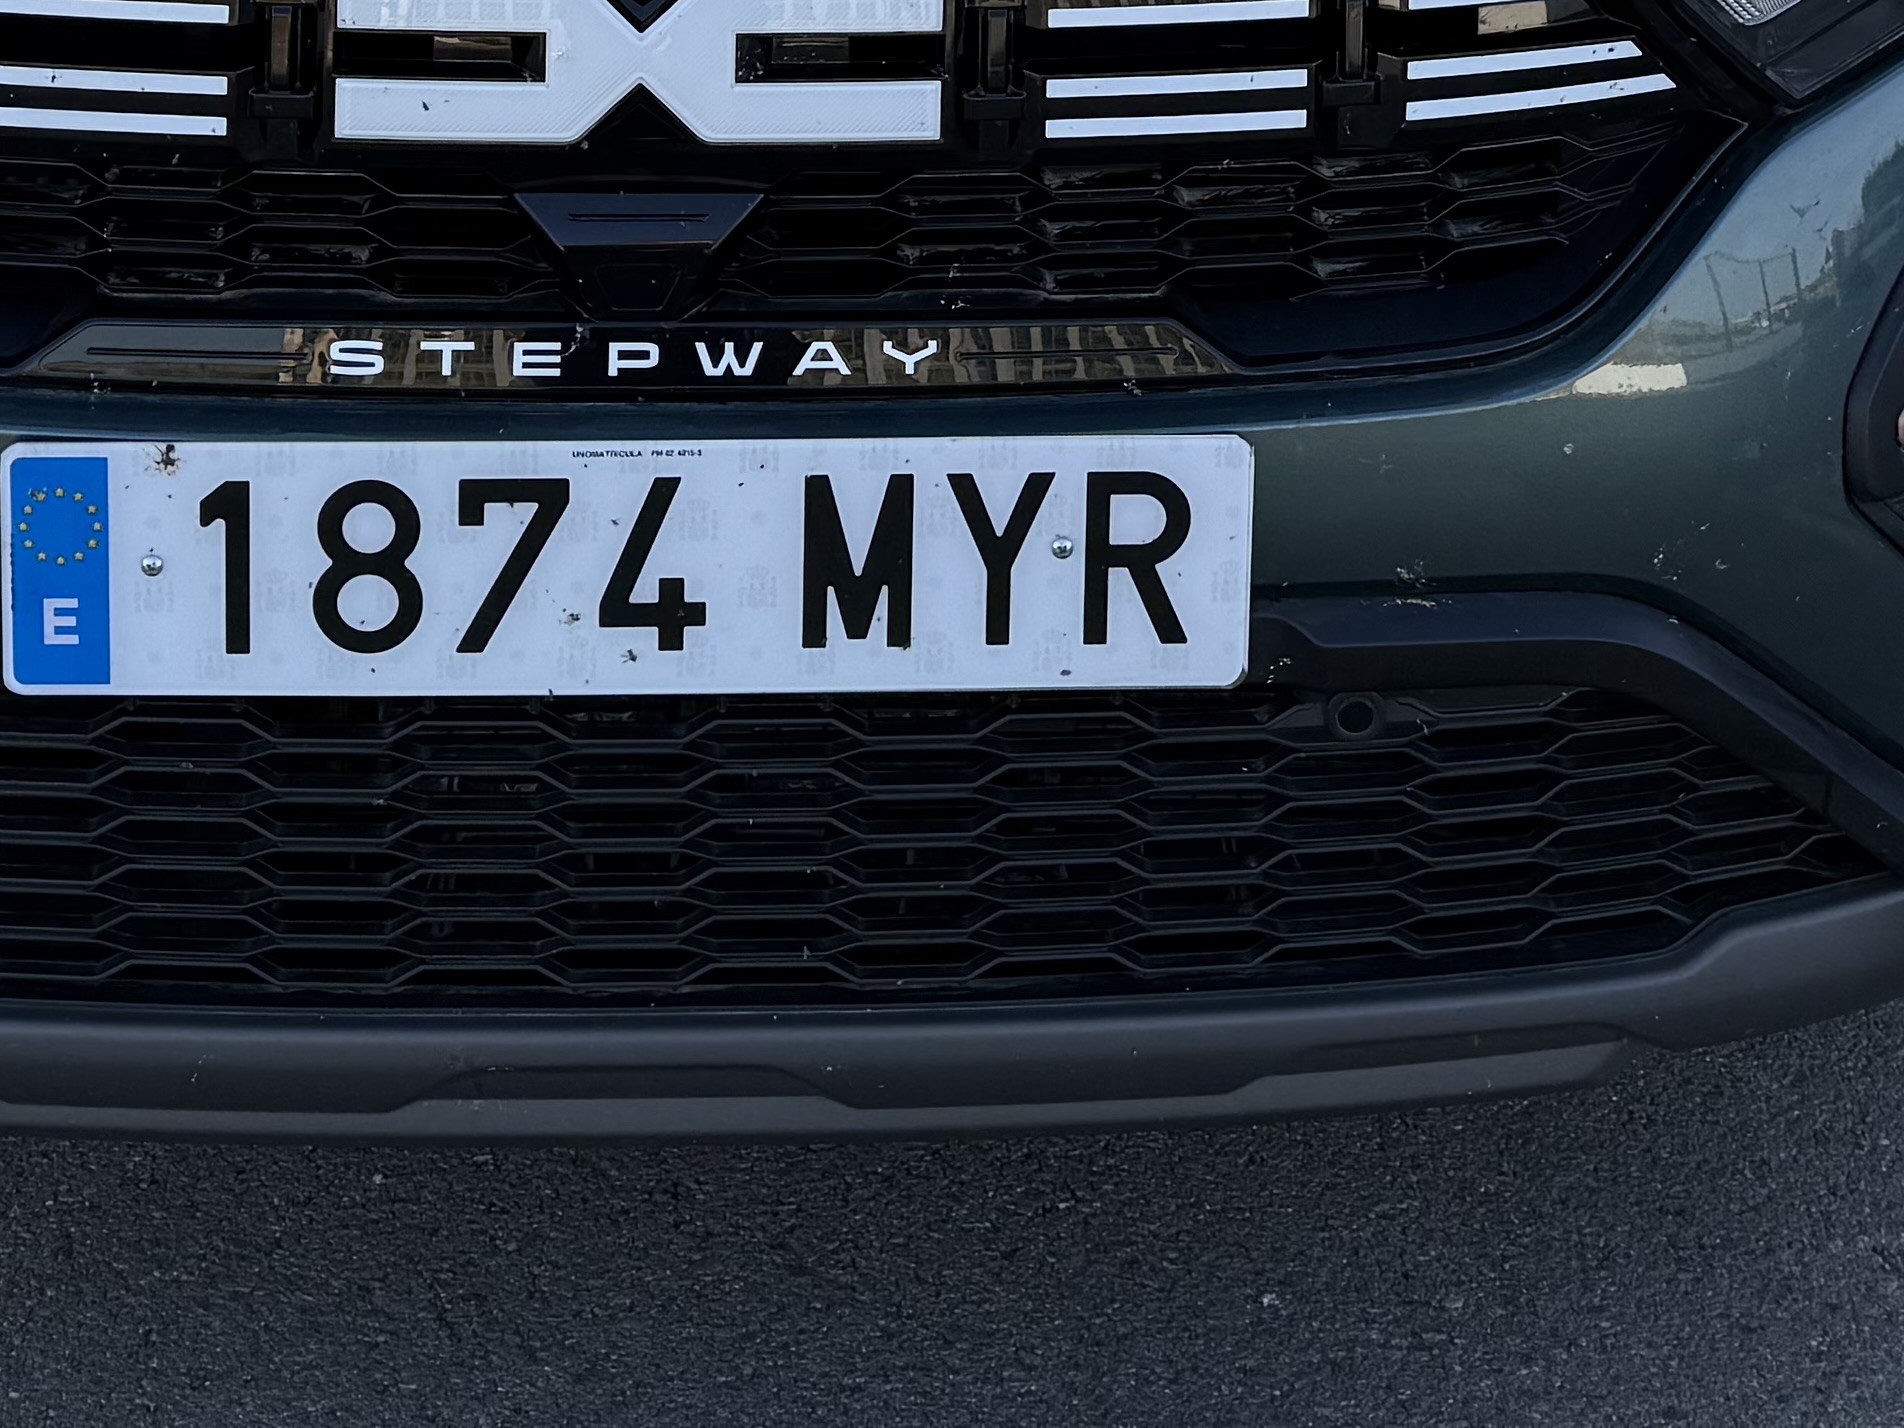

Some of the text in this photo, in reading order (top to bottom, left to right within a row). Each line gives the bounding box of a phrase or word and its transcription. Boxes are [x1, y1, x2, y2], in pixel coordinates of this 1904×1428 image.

[328, 339, 939, 378] STEPWAY
[198, 470, 1193, 655] 1874 MYR
[42, 597, 81, 646] E
